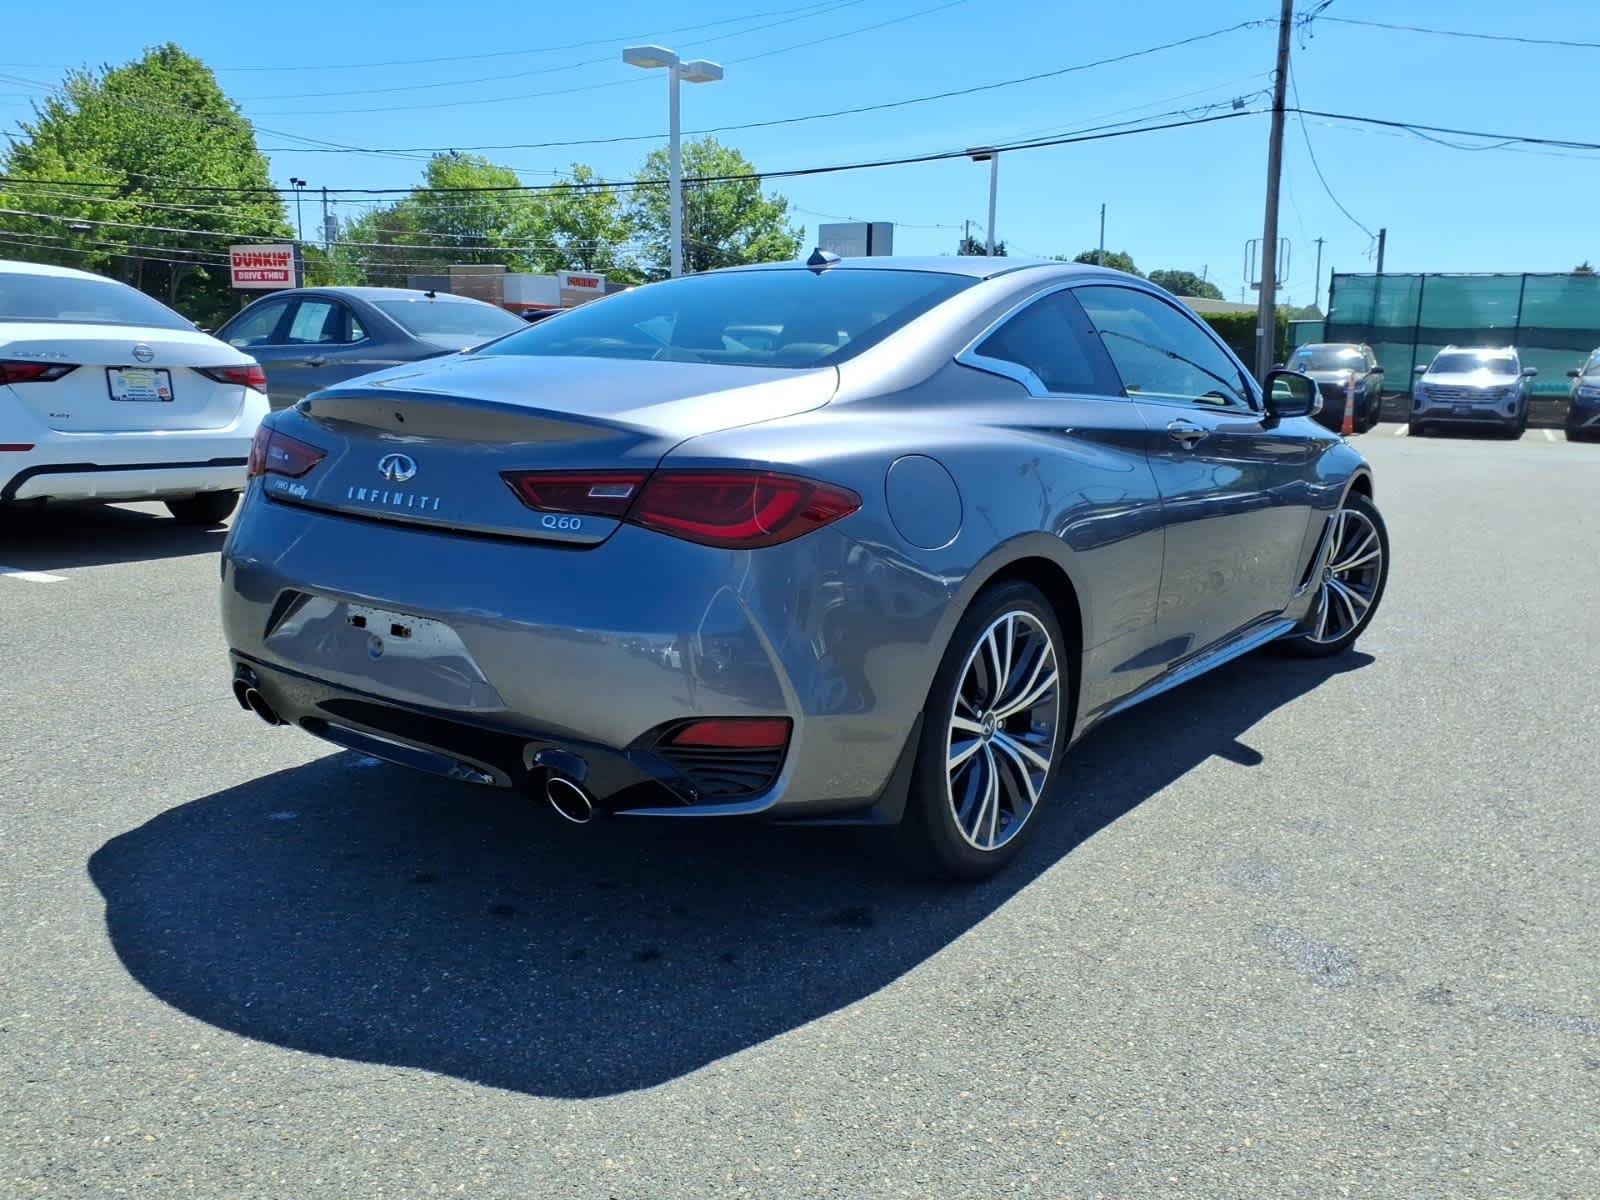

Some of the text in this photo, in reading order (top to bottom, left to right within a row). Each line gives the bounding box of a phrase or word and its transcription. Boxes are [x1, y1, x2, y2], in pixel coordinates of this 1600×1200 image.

[232, 252, 291, 267] DUNKIN'
[238, 271, 285, 280] DRIVE THRU
[347, 486, 441, 511] INFINITI
[542, 514, 581, 530] Q60
